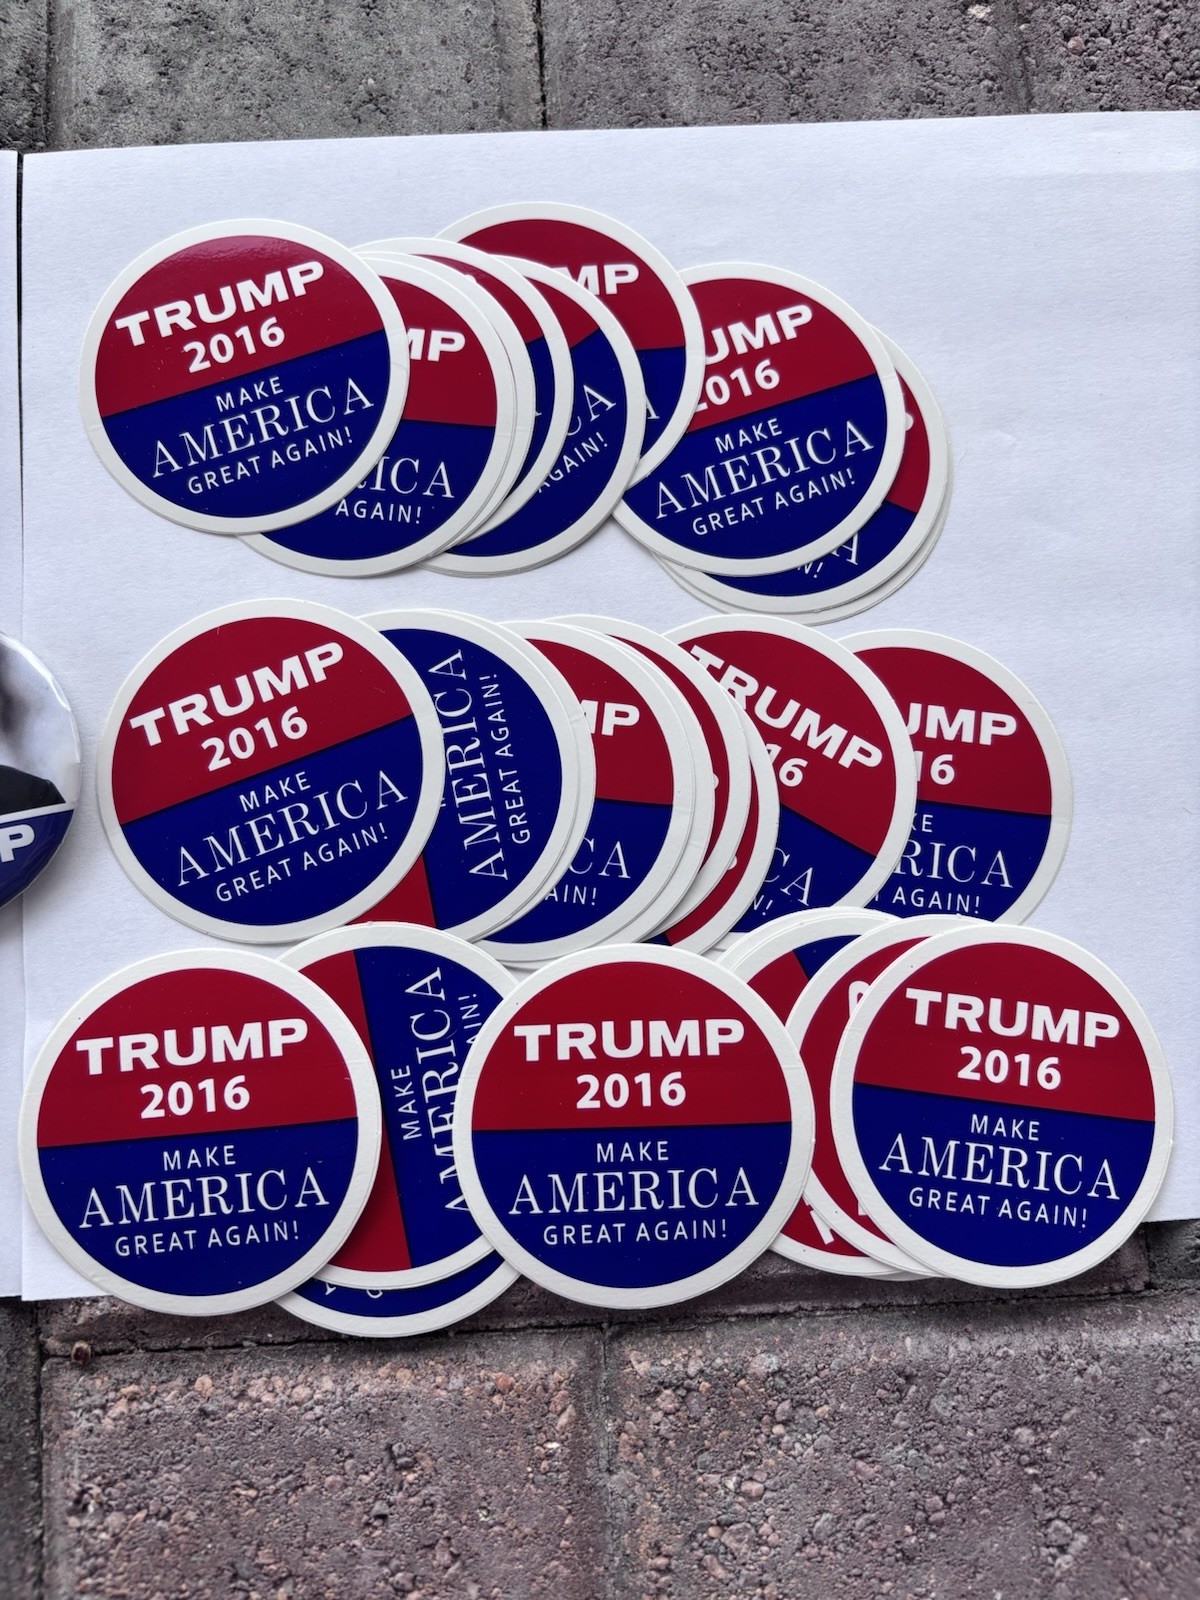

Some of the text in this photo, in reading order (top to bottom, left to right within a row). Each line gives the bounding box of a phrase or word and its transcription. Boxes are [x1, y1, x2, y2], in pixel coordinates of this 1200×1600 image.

[115, 261, 324, 346] TRUMP
[183, 316, 285, 373] 2016
[704, 304, 813, 366] UMP
[215, 376, 284, 412] MAKE
[152, 377, 374, 478] AMERICA
[715, 418, 782, 453] MAKE
[188, 426, 353, 494] GREAT AGAIN!
[655, 420, 874, 519] AMERICA
[335, 498, 421, 524] AGAIN!
[692, 468, 856, 536] GREAT AGAIN!
[129, 642, 344, 747] TRUMP
[201, 706, 308, 771] 2016
[906, 702, 1017, 746] UMP
[428, 649, 508, 881] AMERICA
[479, 673, 531, 844] GREAT AGAIN!
[913, 750, 955, 785] 16
[239, 771, 311, 812] MAKE
[178, 769, 408, 886] AMERICA
[216, 822, 388, 902] GREAT AGAIN!
[893, 839, 1014, 888] RICA
[545, 884, 596, 906] AIN!
[892, 886, 980, 914] AGAIN!
[513, 1018, 745, 1062] TRUMP
[905, 987, 1120, 1048] TRUMP
[76, 1018, 308, 1076] TRUMP
[957, 1045, 1061, 1090] 2016
[140, 1075, 250, 1119] 2016
[391, 1065, 422, 1140] MAKE
[575, 1071, 686, 1109] 2016
[596, 1141, 669, 1163] MAKE
[970, 1114, 1040, 1141] MAKE
[162, 1145, 236, 1171] MAKE
[878, 1132, 1120, 1200] AMERICA
[79, 1166, 329, 1229] AMERICA
[509, 1166, 759, 1215] AMERICA
[909, 1186, 1087, 1228] GREAT AGAIN!
[115, 1220, 299, 1257] GREAT AGAIN!
[543, 1219, 727, 1245] GREAT AGAIN!
